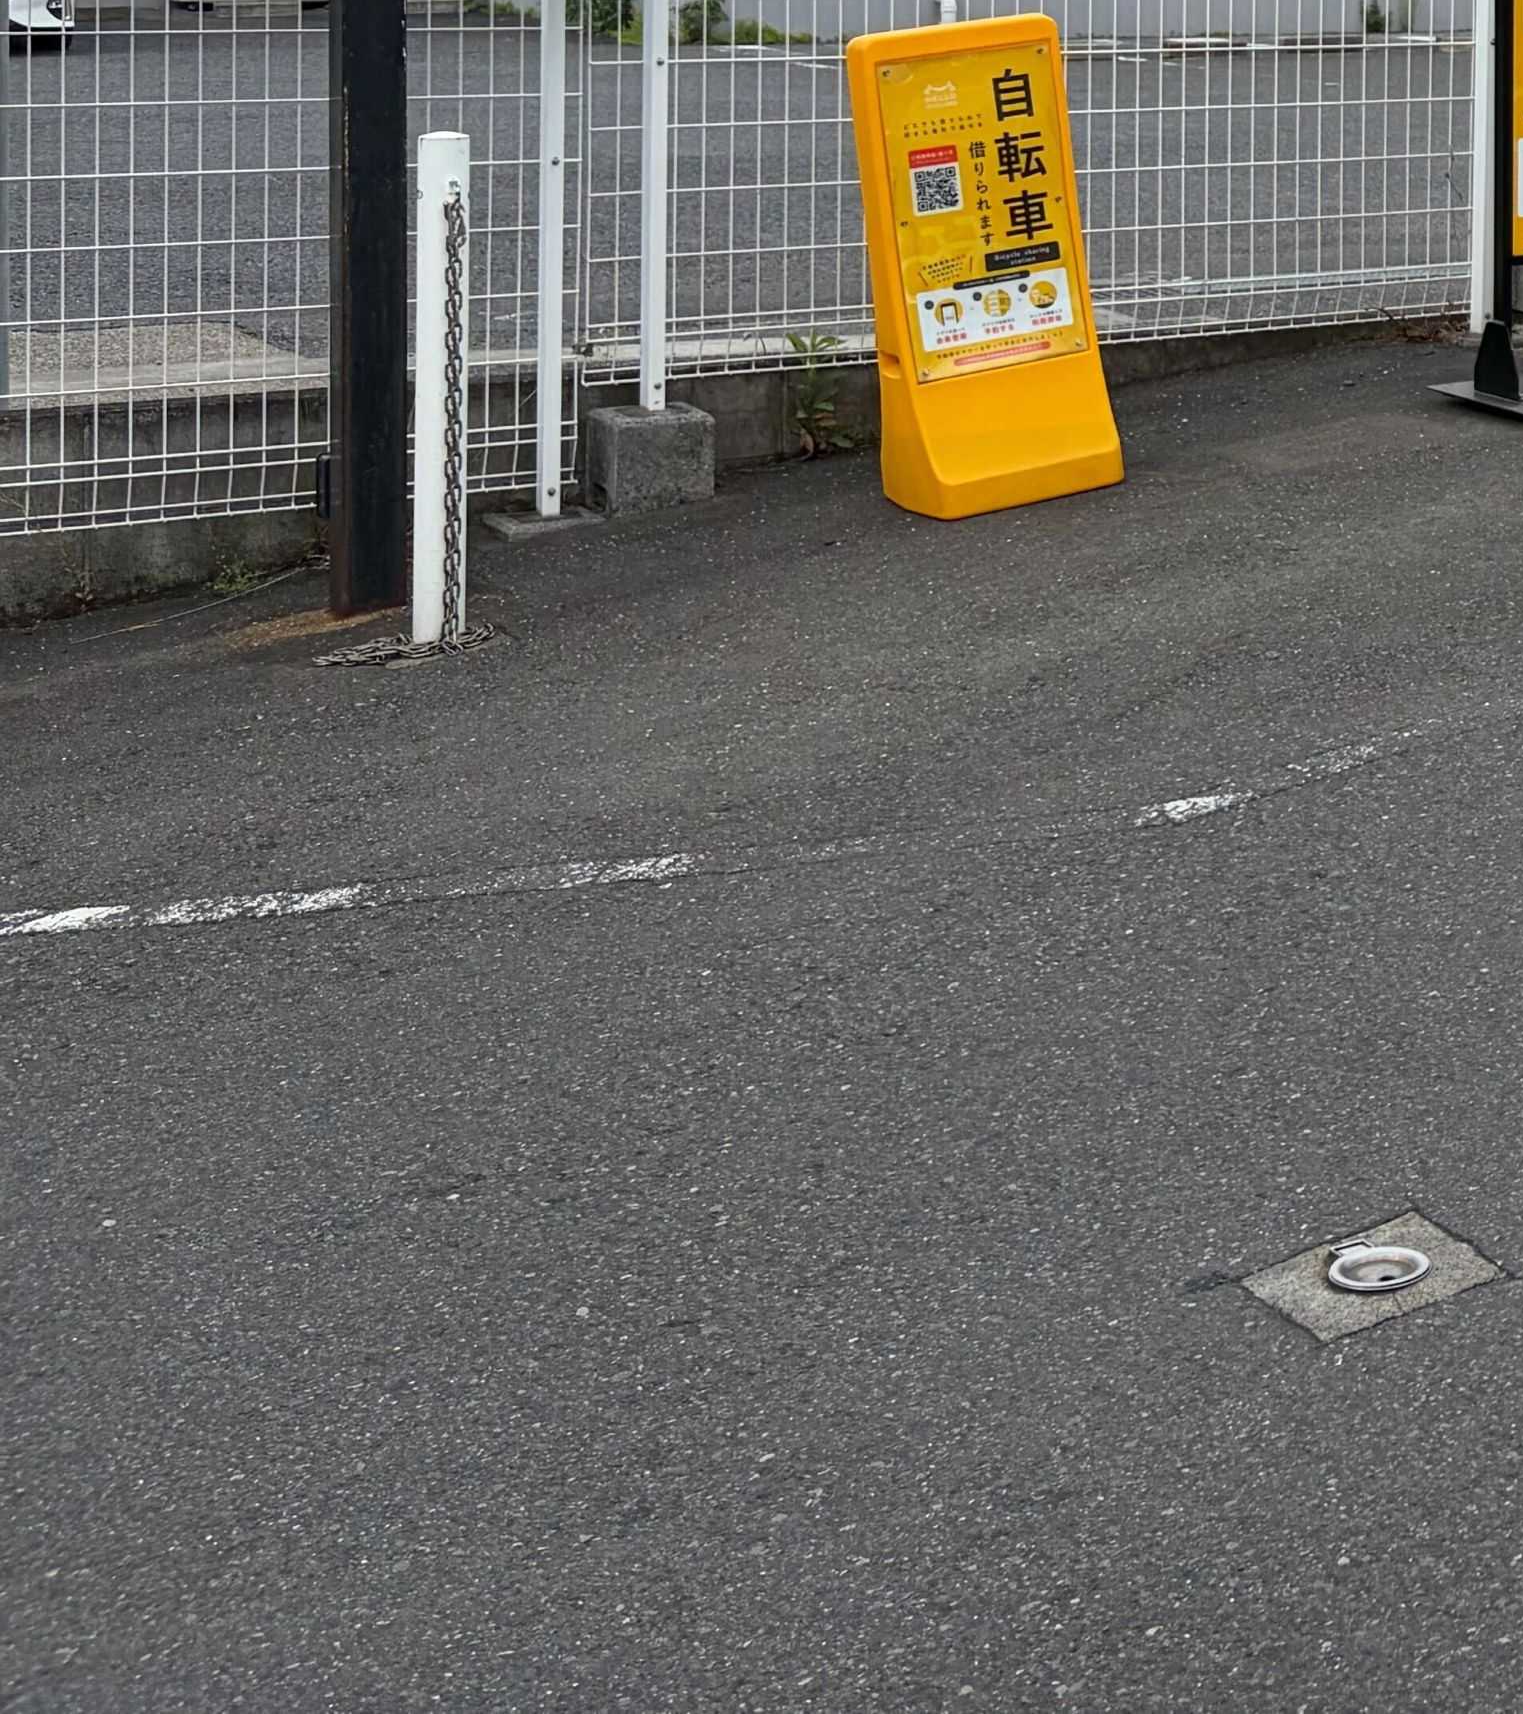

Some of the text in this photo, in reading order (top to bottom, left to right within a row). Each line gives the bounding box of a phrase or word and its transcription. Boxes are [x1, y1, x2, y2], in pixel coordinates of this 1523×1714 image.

[969, 141, 995, 247] 借りられます
[992, 69, 1053, 240] 自転車
